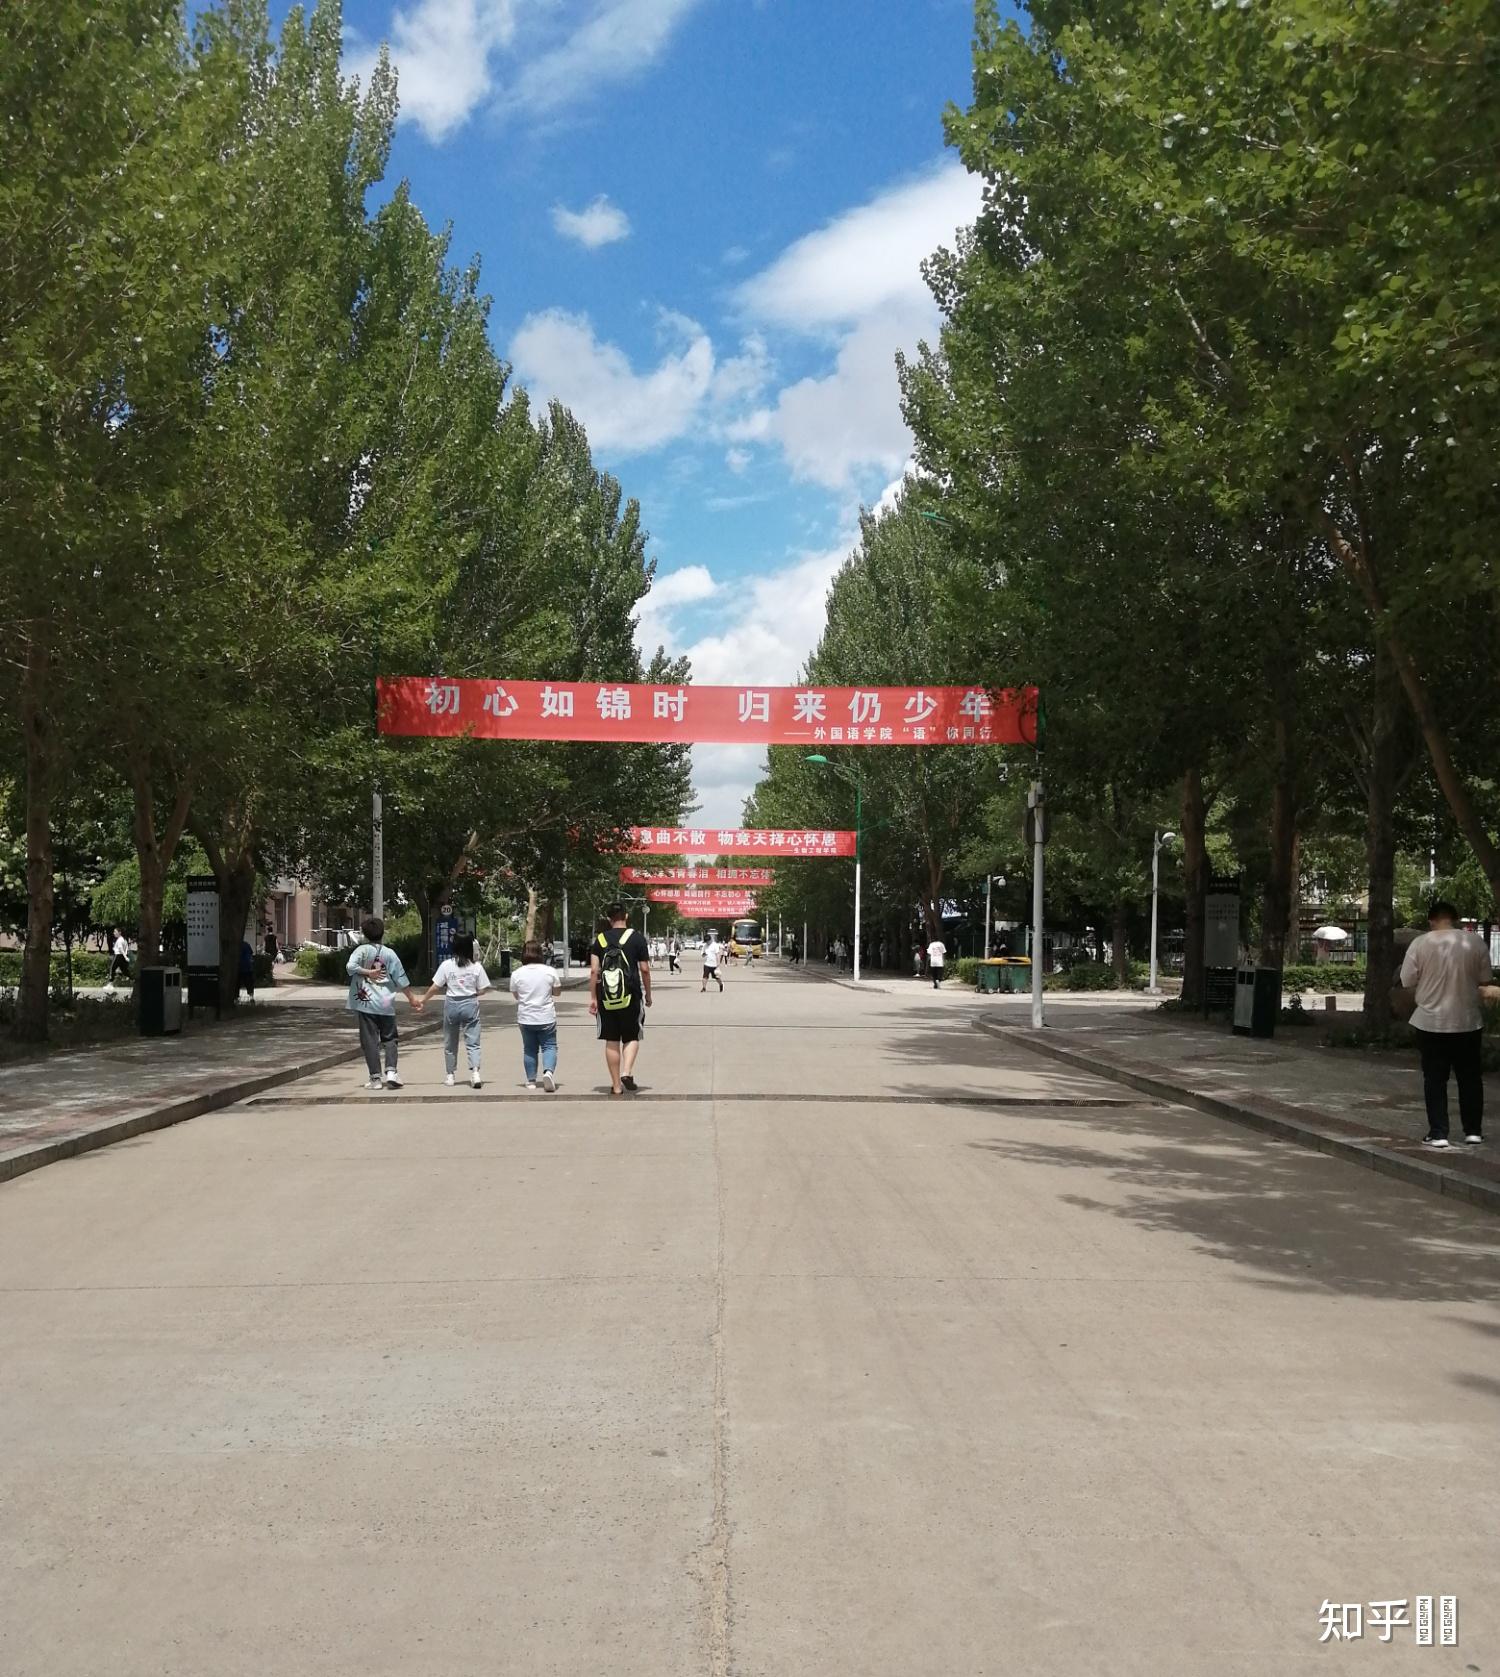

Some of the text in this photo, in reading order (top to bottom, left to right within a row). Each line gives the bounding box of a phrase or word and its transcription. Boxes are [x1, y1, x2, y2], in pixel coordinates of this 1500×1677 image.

[425, 682, 993, 723] 初心如锦时 归来仍少年
